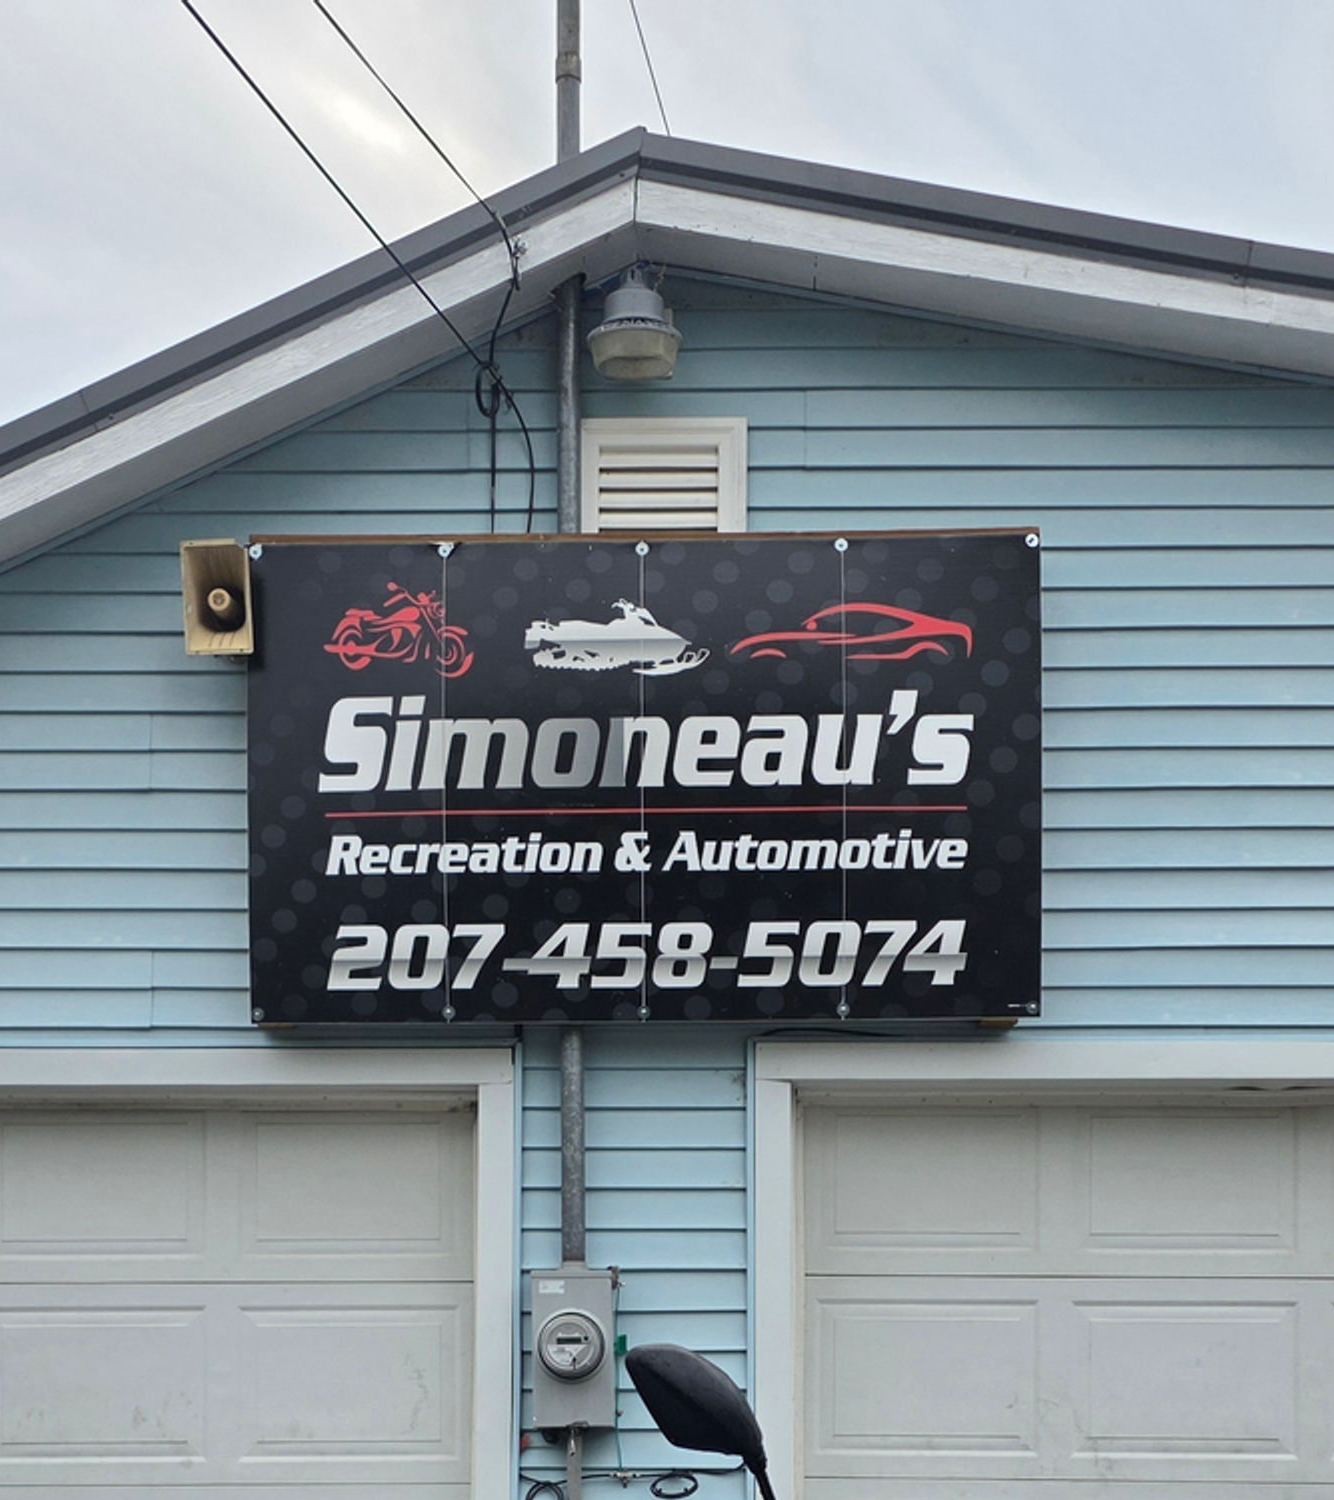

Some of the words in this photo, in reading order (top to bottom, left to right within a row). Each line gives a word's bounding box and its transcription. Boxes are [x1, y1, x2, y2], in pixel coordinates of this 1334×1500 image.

[317, 689, 975, 793] Simoneau's
[325, 832, 604, 876] Recreation
[614, 830, 652, 873] &
[661, 829, 969, 872] Automotive
[326, 919, 968, 991] 207-458-5074
